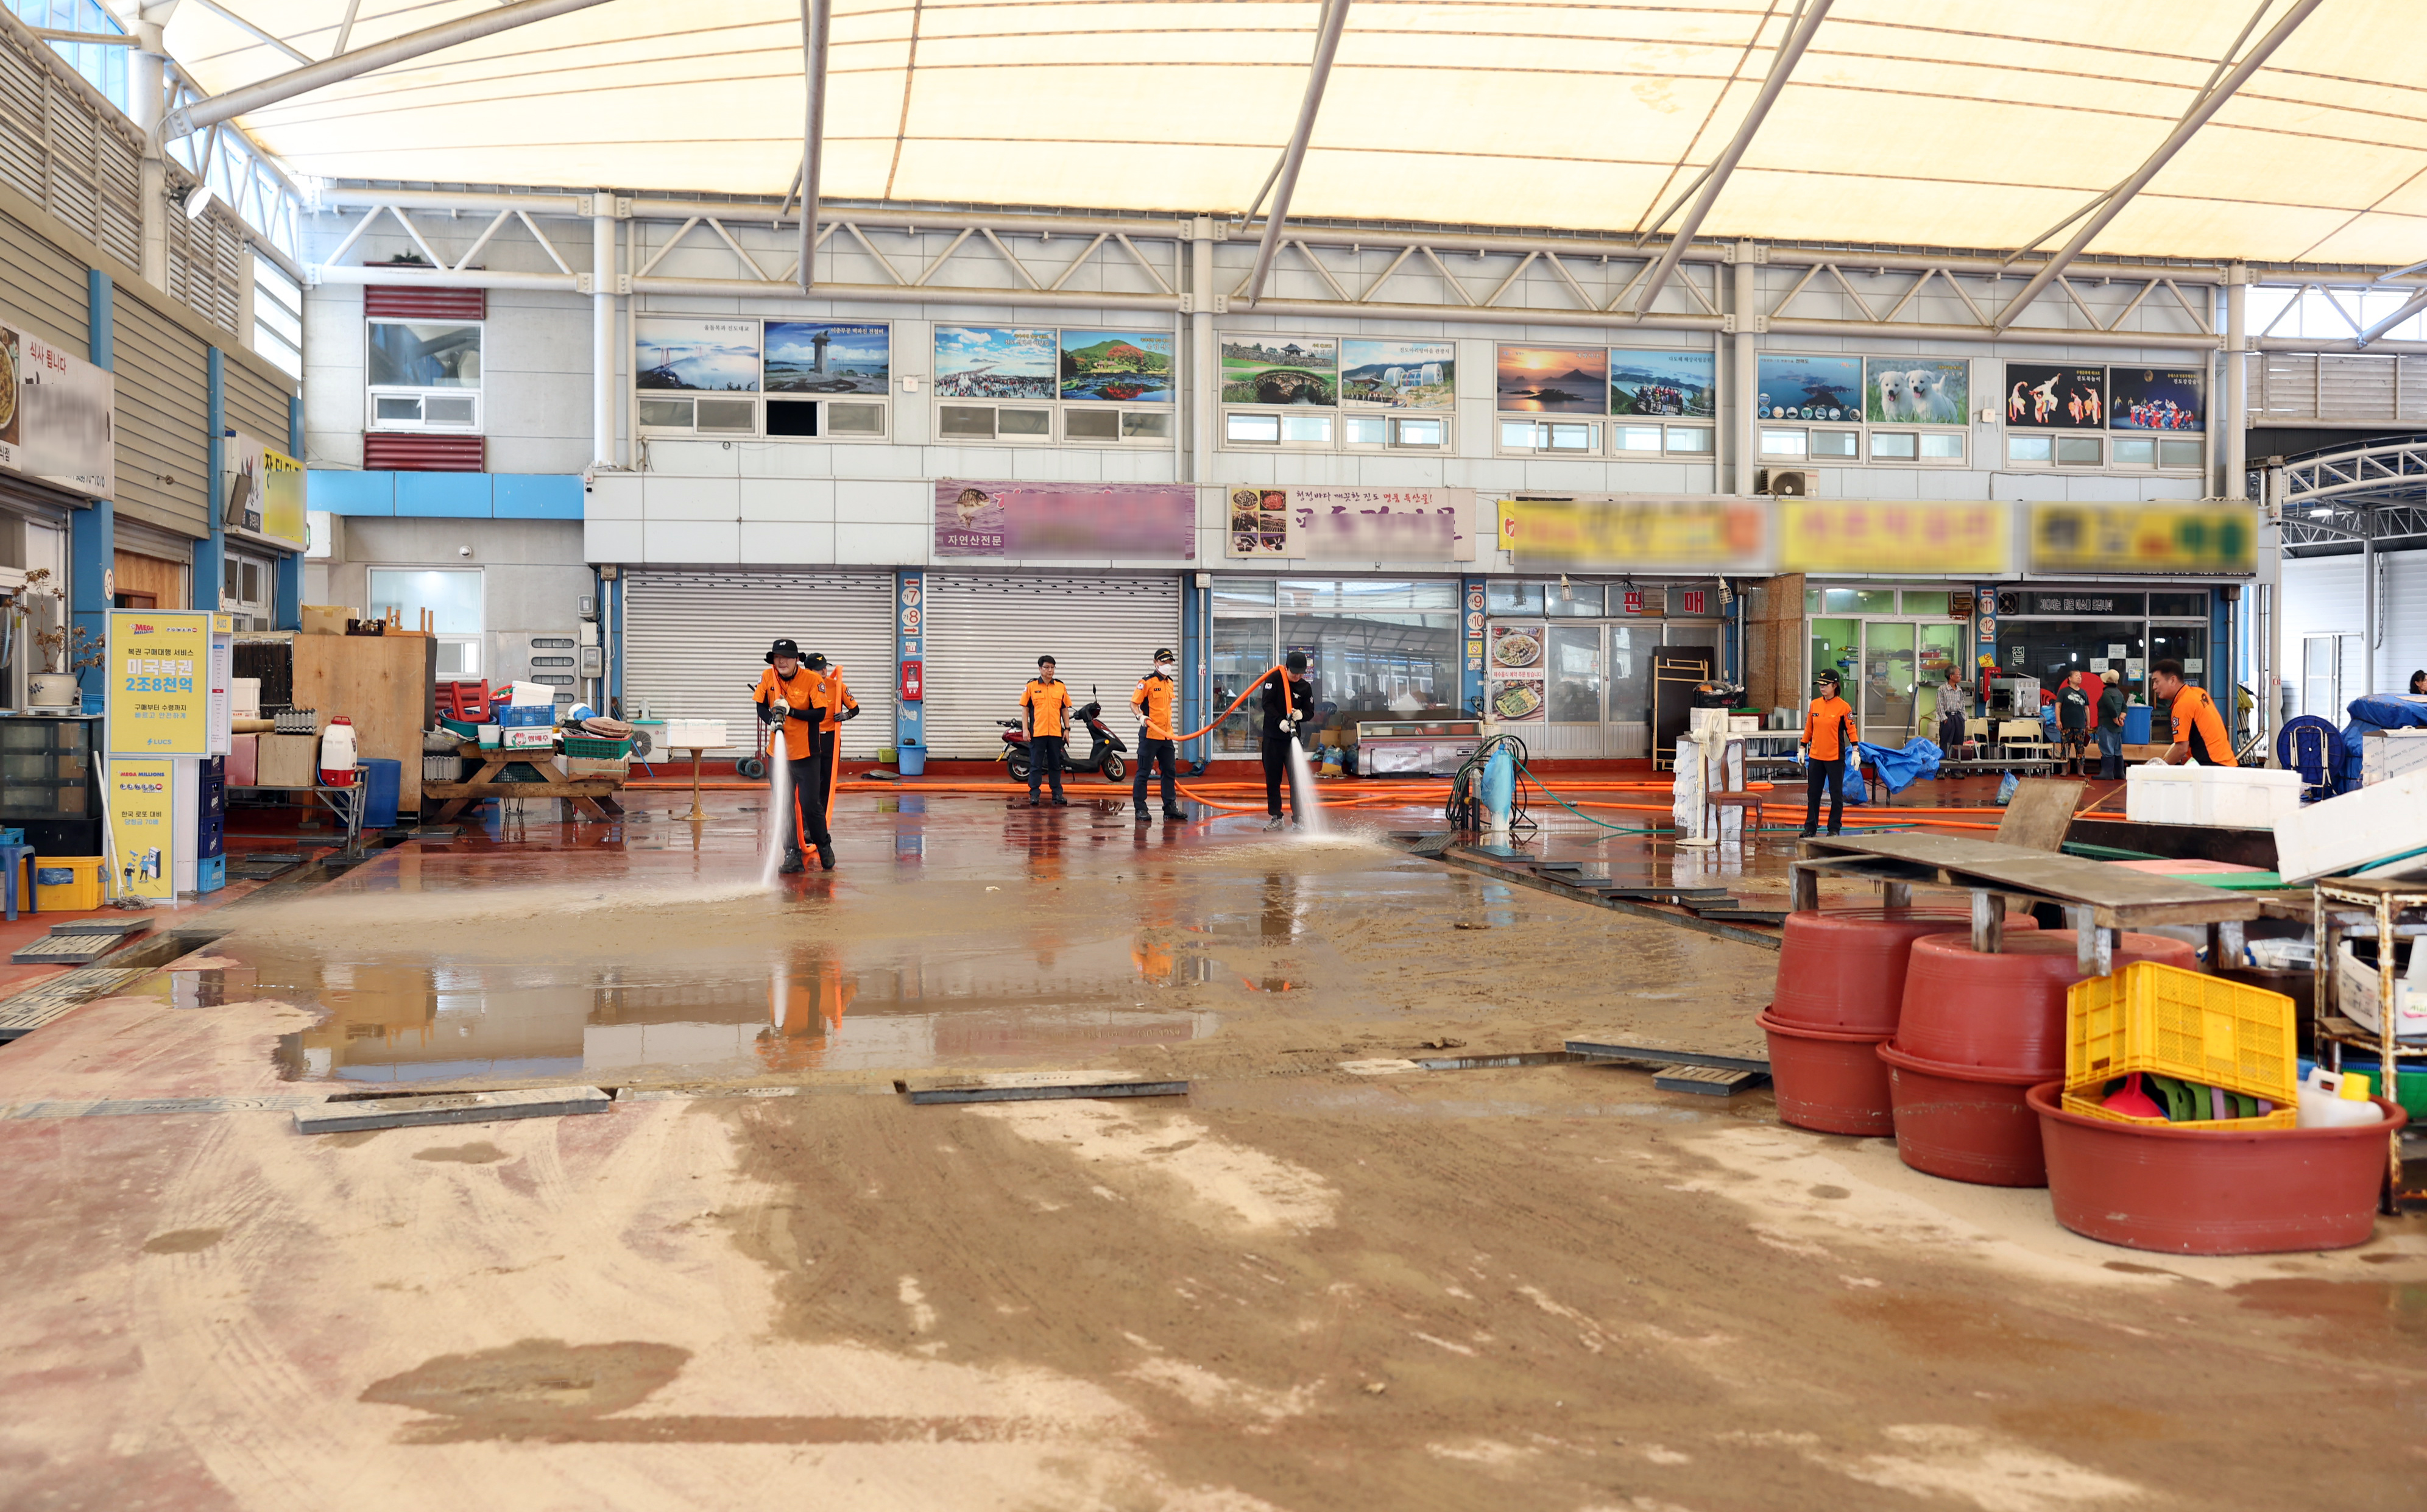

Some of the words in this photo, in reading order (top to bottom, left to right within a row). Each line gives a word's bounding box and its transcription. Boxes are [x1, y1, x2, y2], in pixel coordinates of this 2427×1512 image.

[30, 342, 44, 365] 식사
[46, 349, 66, 375] 됩니다
[1296, 490, 1330, 501] 청정바다
[1334, 493, 1360, 502] 깨끗한
[1364, 493, 1379, 501] 진도
[1383, 493, 1400, 503] 명품
[1404, 494, 1433, 504] 특산물!
[948, 535, 1002, 546] 자연산전문
[1623, 591, 1641, 613] 판
[1684, 590, 1705, 613] 매
[2064, 599, 2074, 610] 밝은
[2075, 599, 2091, 610] 미소를
[2092, 599, 2113, 611] 드립니다
[127, 659, 193, 676] 미국복권
[125, 677, 193, 693] 2조8천억
